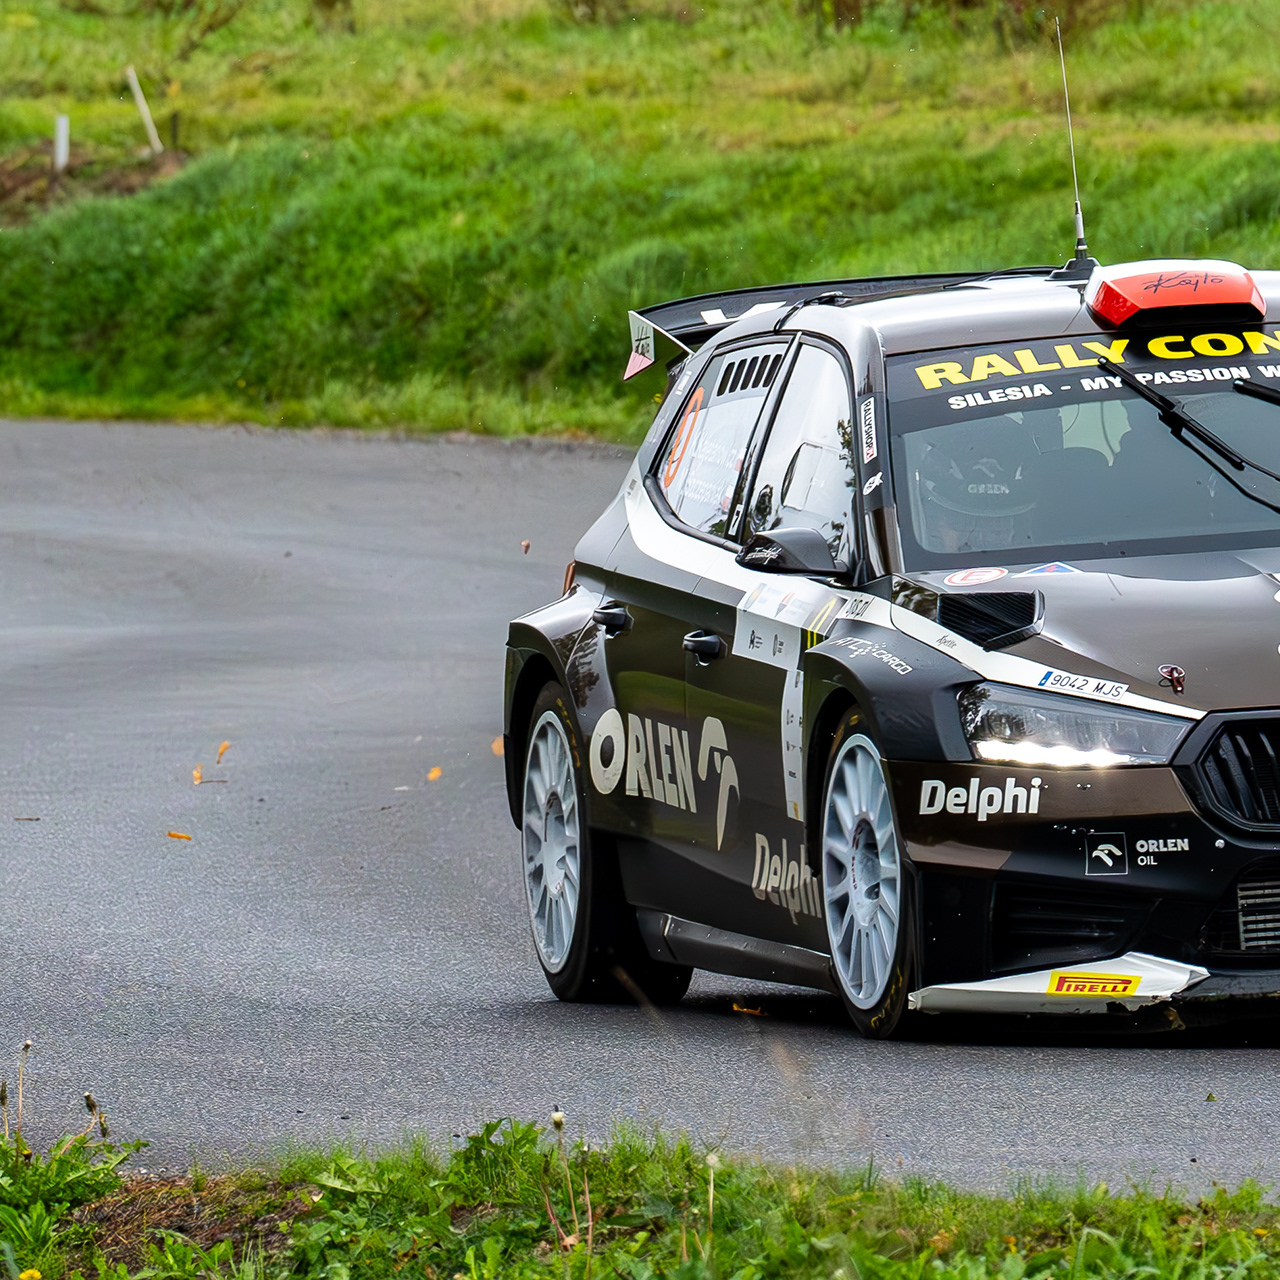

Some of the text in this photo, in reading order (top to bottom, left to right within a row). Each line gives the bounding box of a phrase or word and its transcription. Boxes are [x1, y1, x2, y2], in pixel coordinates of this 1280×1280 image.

[915, 339, 1130, 390] RALLY
[948, 383, 1053, 410] SILESIA
[1080, 376, 1123, 392] MY
[1134, 367, 1249, 386] PASSION
[871, 649, 913, 676] CARGO
[1051, 675, 1123, 697] 9042 MJS
[589, 707, 697, 814] ORLEN
[919, 776, 1042, 822] Delphi
[1135, 838, 1190, 853] ORLEN
[1137, 855, 1158, 866] OIL
[1056, 975, 1132, 993] PIRELLI
